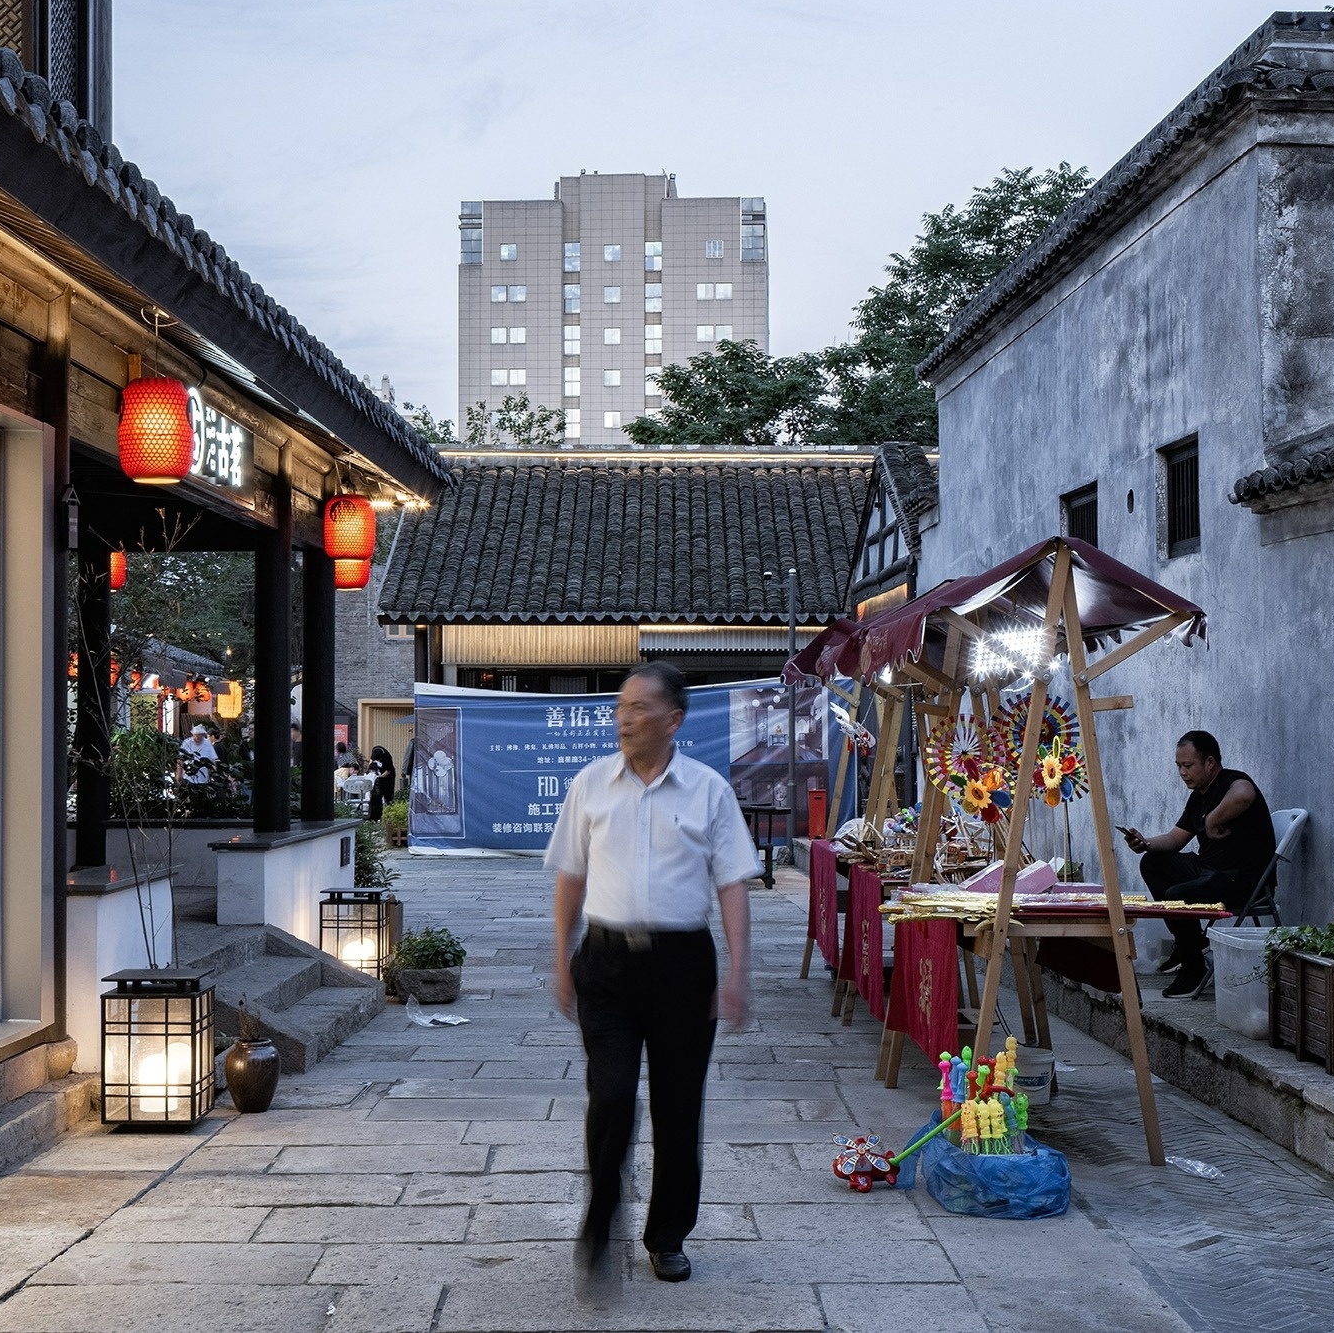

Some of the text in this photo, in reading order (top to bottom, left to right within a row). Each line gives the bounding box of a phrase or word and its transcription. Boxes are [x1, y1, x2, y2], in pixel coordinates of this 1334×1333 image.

[545, 705, 614, 728] 善佑堂
[537, 776, 559, 797] FID
[492, 822, 557, 833] 装修咨询联系
